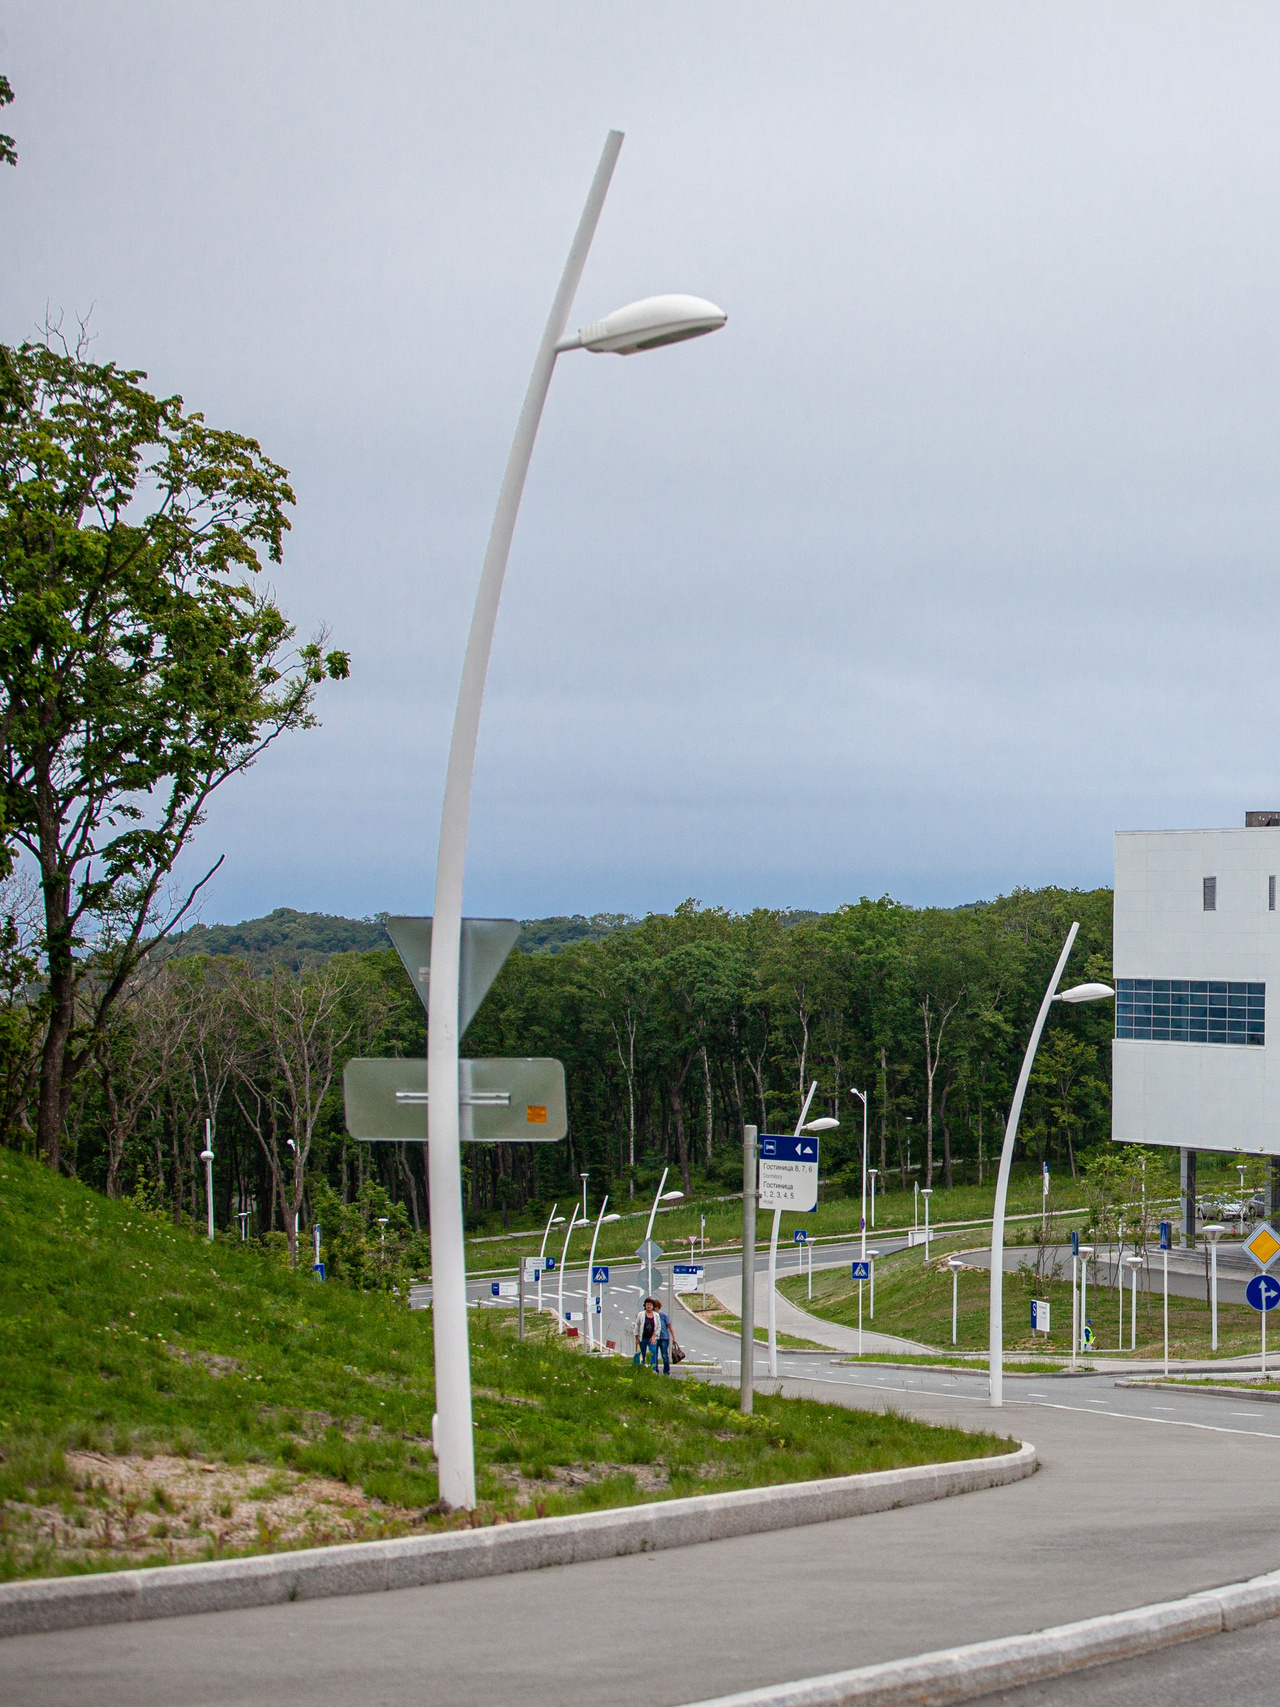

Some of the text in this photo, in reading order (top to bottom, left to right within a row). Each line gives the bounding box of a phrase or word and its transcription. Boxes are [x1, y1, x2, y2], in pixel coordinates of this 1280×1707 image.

[763, 1163, 793, 1172] Гостиница
[794, 1165, 800, 1173] 8,
[801, 1165, 807, 1173] 7,
[763, 1181, 793, 1190] Гостиница
[776, 1191, 782, 1199] 3,
[1032, 1303, 1037, 1316] S
